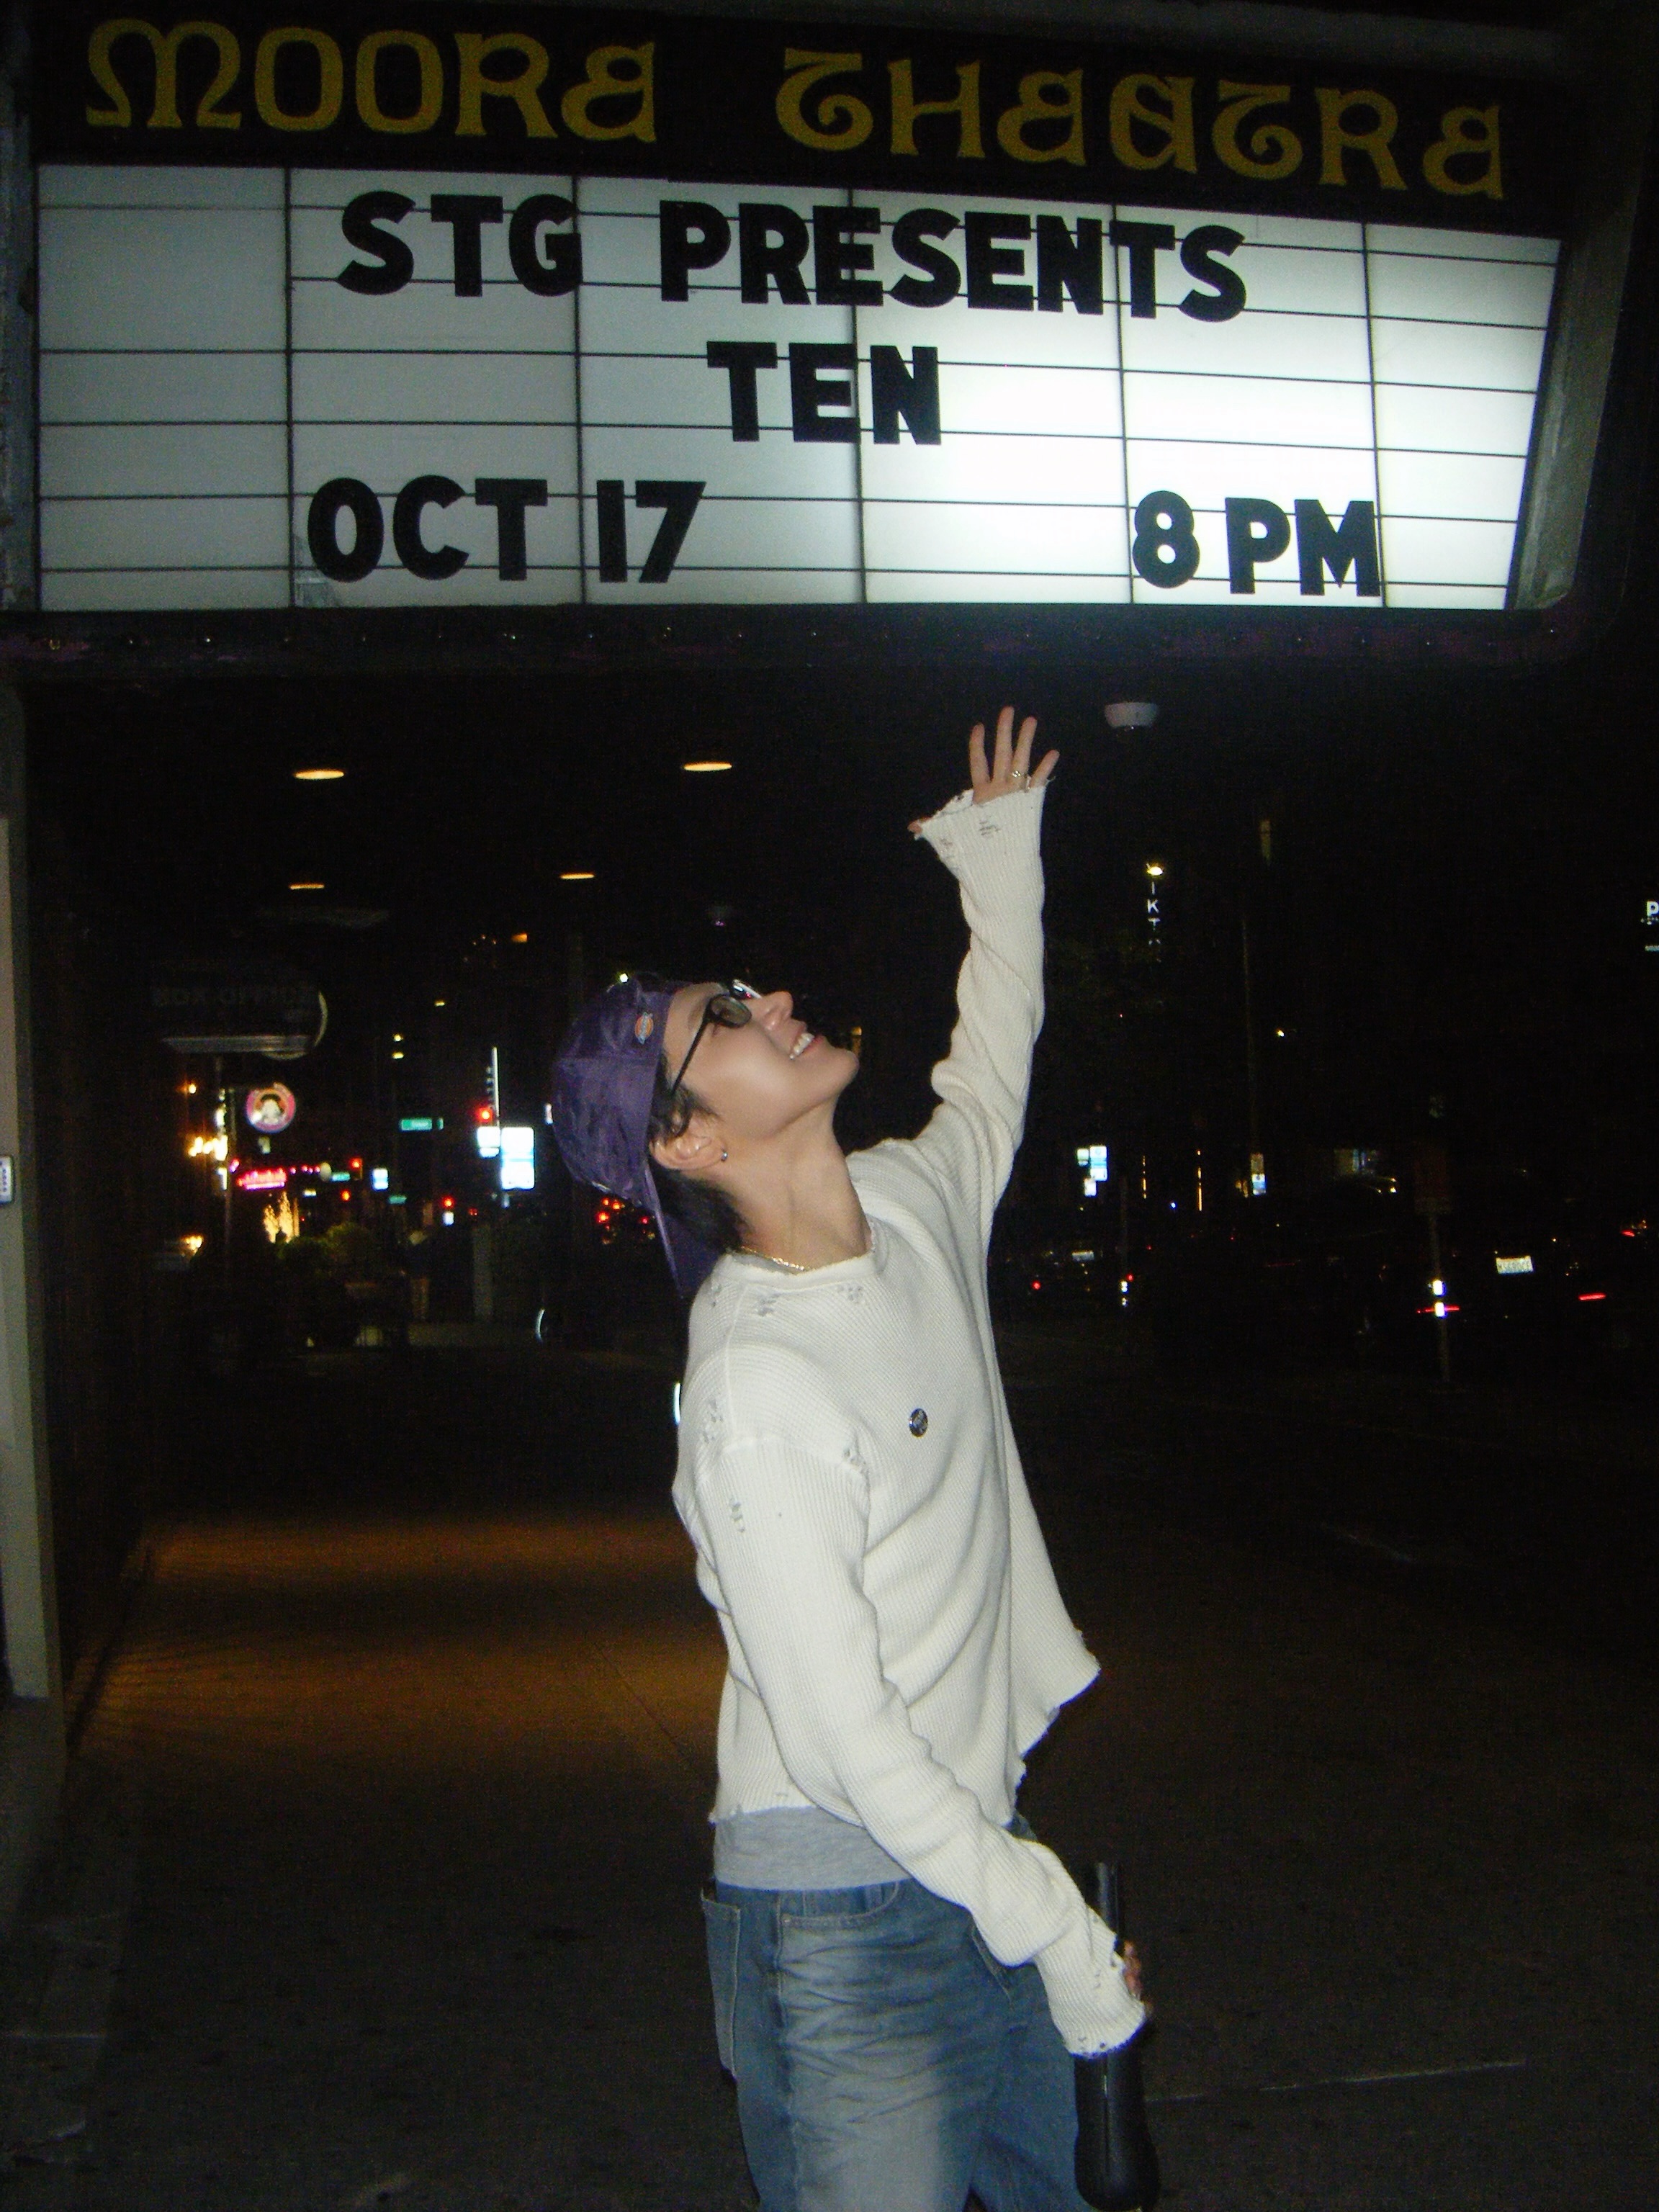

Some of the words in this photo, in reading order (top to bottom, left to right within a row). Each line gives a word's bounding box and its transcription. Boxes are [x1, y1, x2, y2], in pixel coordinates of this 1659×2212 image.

[86, 18, 657, 142] MOORE
[775, 47, 1504, 201] THEATRE
[336, 190, 583, 297] STG
[659, 199, 1246, 323] PRESENTS
[706, 341, 940, 445] TEN
[307, 475, 548, 583] OCT
[596, 480, 706, 583] 17
[1132, 490, 1200, 589] 8
[1225, 497, 1381, 597] PM
